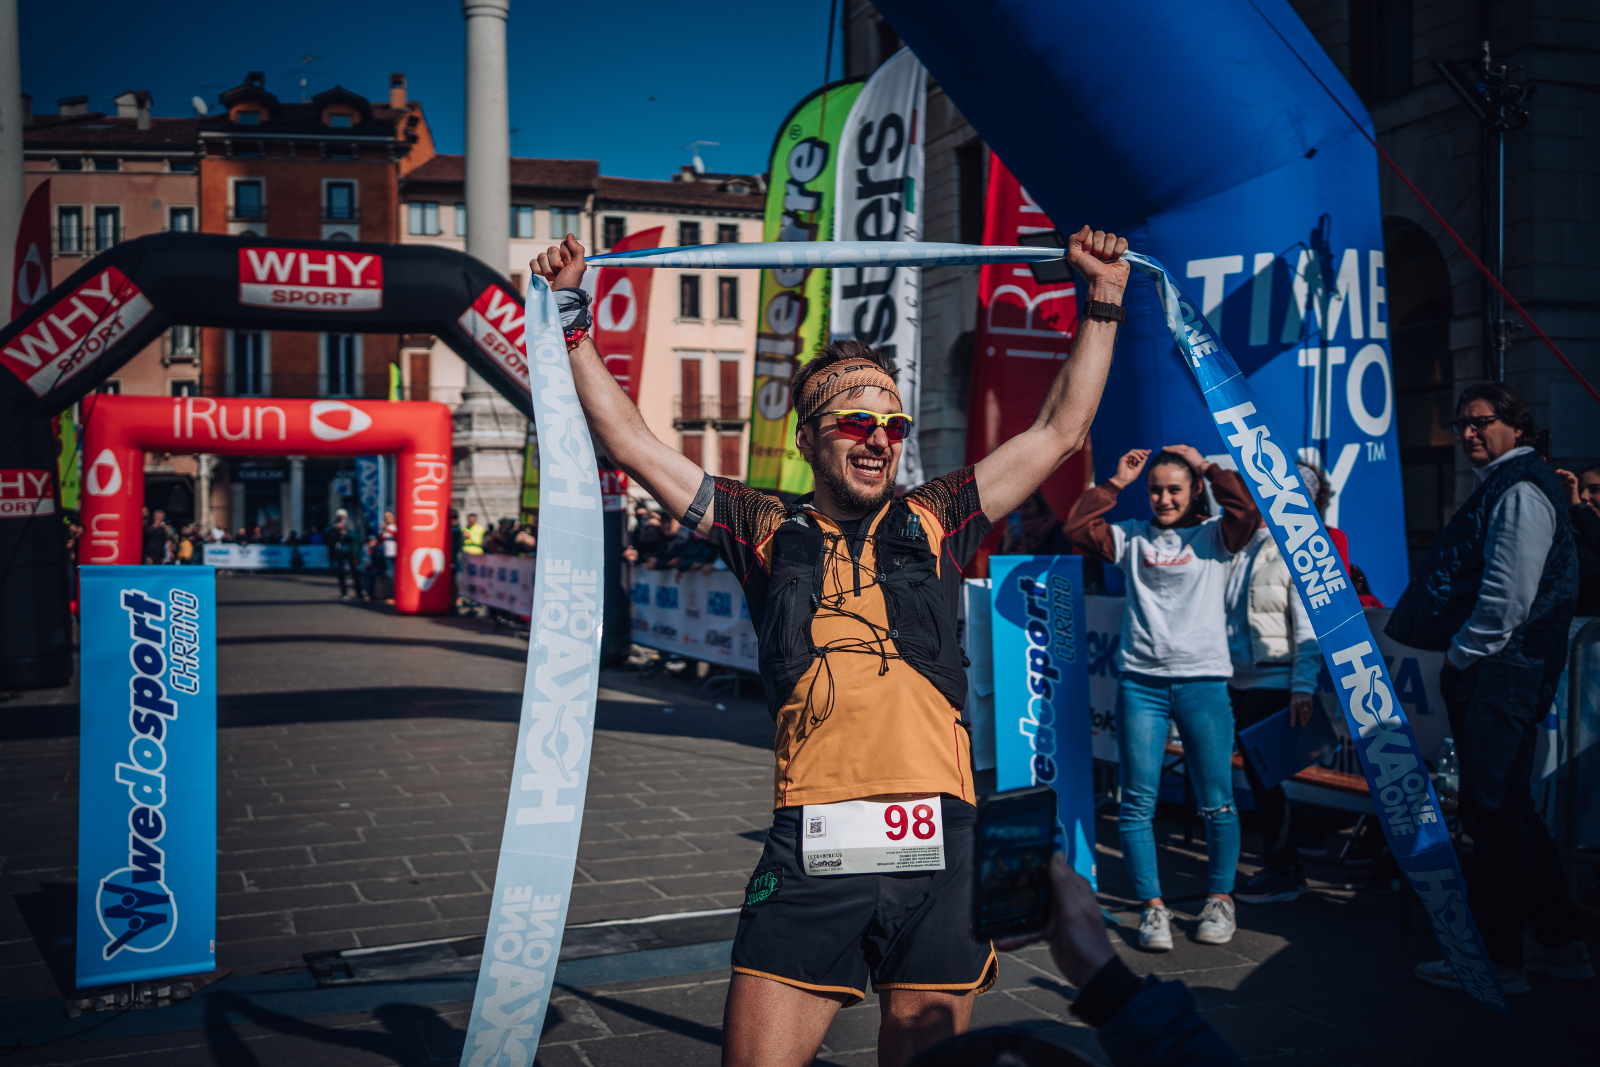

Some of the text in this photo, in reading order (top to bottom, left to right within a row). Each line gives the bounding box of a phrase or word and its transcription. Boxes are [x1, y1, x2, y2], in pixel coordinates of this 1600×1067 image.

[246, 249, 374, 287] WHY
[270, 288, 354, 307] SPORT
[1186, 248, 1387, 347] TIME
[2, 270, 120, 368] WHY
[57, 314, 127, 375] SPORT
[173, 397, 287, 441] iRun
[1297, 343, 1393, 440] TO
[411, 453, 447, 532] iRun
[1212, 400, 1320, 555] HOKA
[1292, 549, 1332, 610] ONE
[1308, 534, 1348, 595] ONE
[169, 588, 200, 696] CHRONO
[1051, 574, 1075, 664] CHRONO
[1018, 575, 1061, 787] edosport
[1331, 640, 1419, 789] HOKA
[115, 588, 178, 884] wedosport
[884, 803, 936, 841] 98
[1380, 785, 1417, 839] ONE
[1401, 773, 1438, 828] ONE
